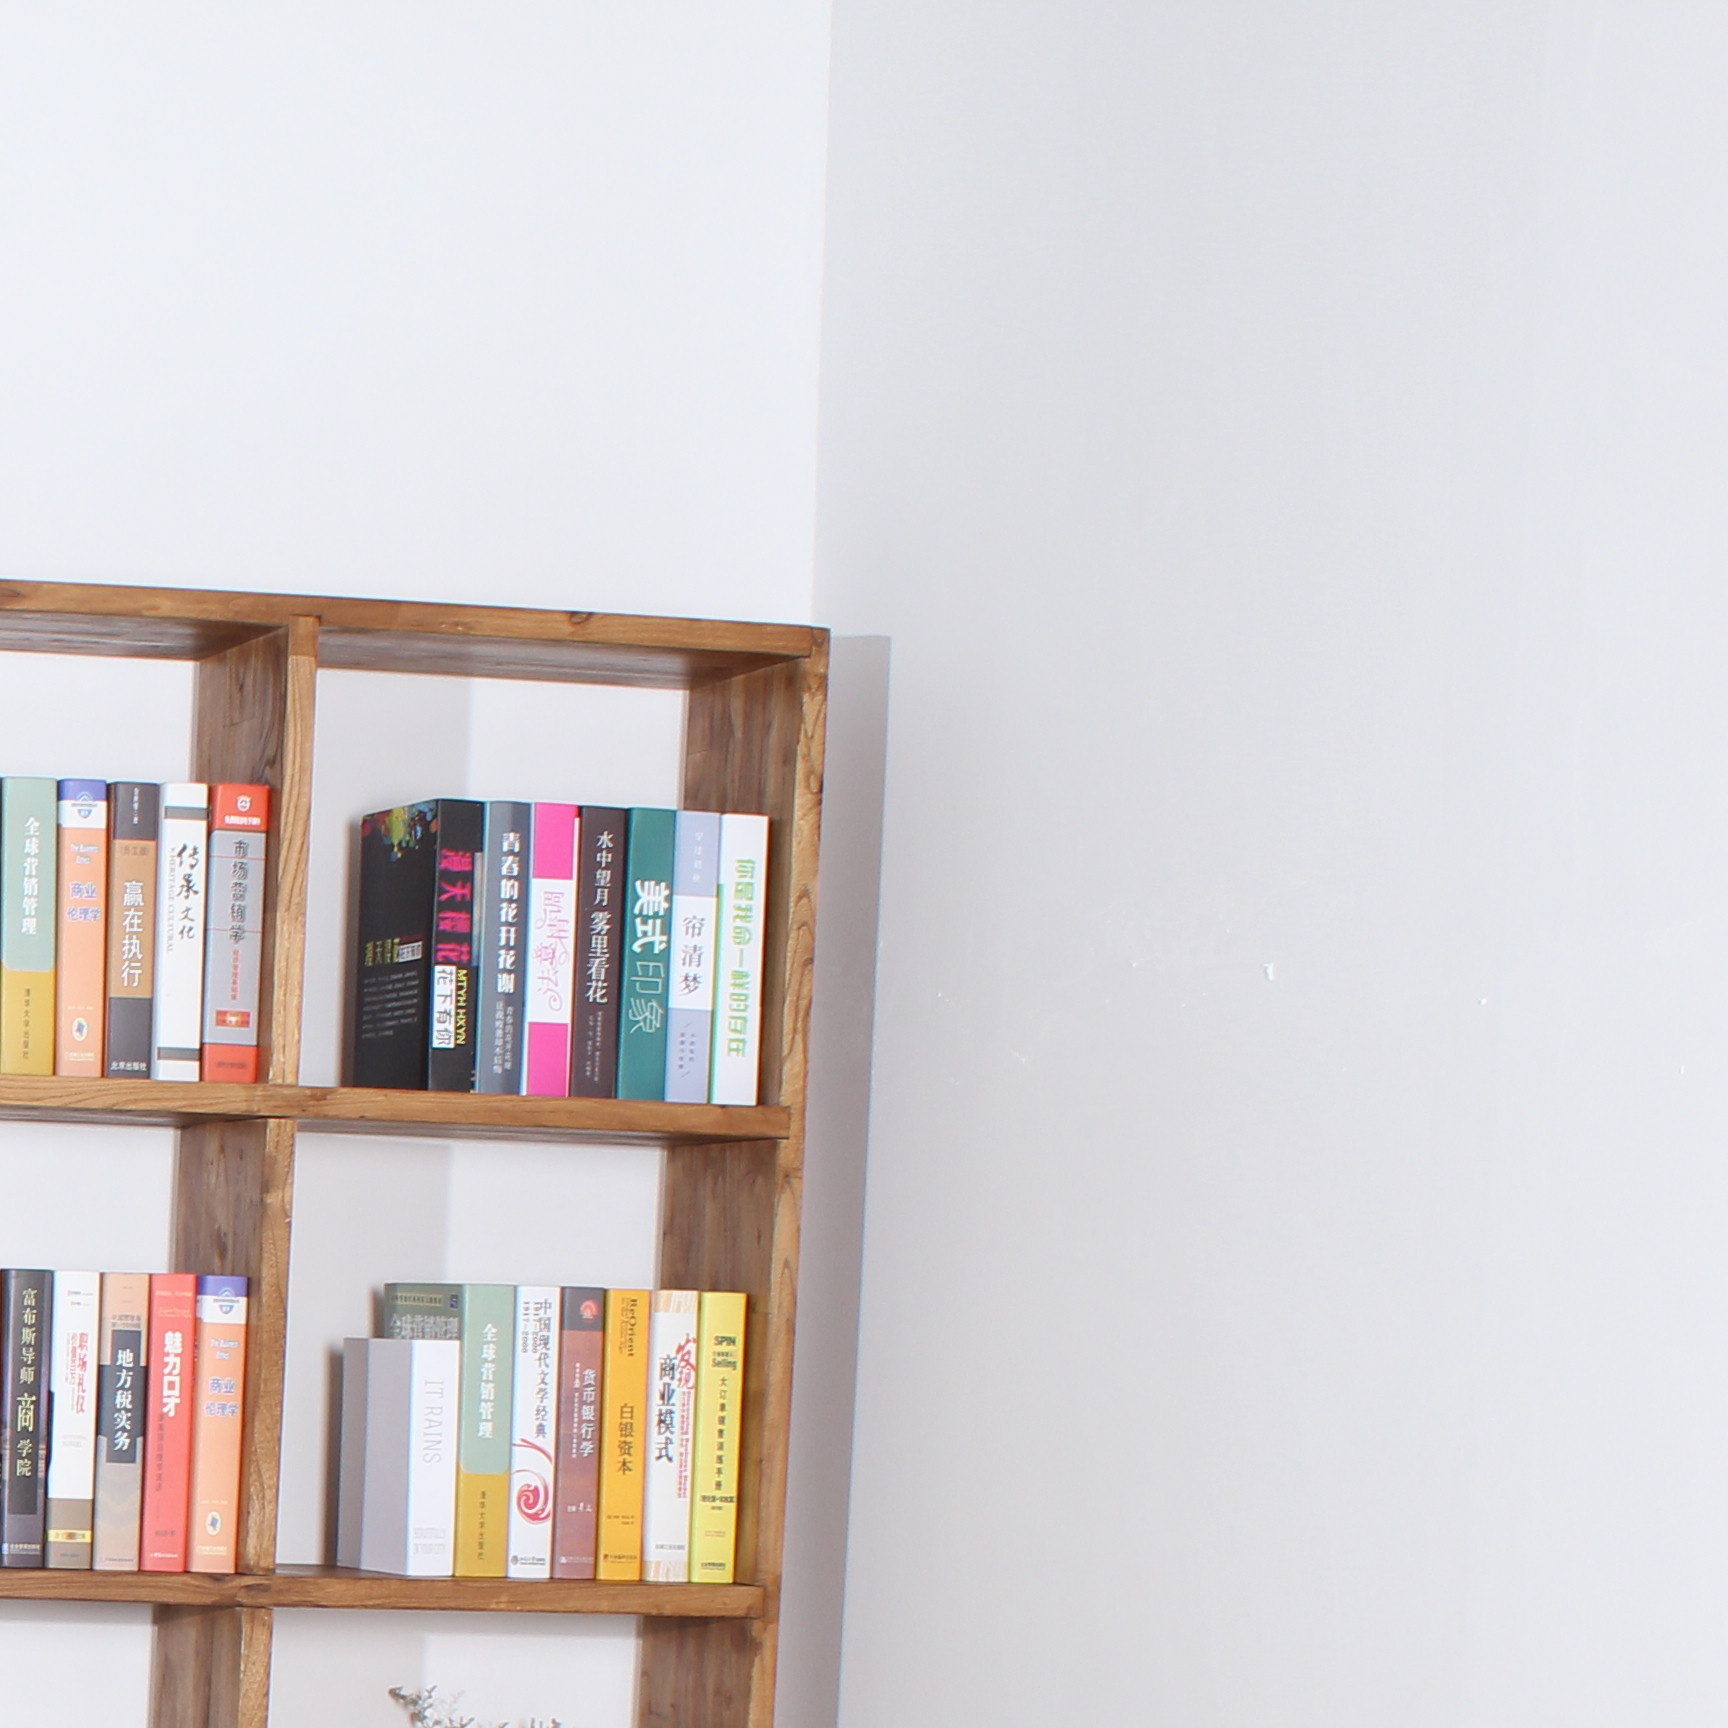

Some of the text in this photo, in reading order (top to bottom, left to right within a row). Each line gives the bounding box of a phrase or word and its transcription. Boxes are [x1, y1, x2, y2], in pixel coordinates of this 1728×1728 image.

[21, 816, 41, 936] 全球营销管理
[70, 881, 96, 899] 商业
[176, 843, 200, 940] 传承文化
[228, 840, 249, 945] 市场营销学
[497, 831, 520, 994] 青春的花开花谢
[594, 831, 615, 906] 水中望月
[67, 906, 101, 922] 伦理学
[121, 880, 145, 988] 赢在执行
[585, 911, 612, 1004] 雾里看花
[630, 879, 672, 1034] 美式印象
[680, 914, 706, 996] 帘清梦
[727, 858, 756, 1058] 你是我命一样的存在
[435, 966, 455, 1047] 花下有你
[456, 969, 468, 1045] MTYH HXYN
[16, 1288, 38, 1477] 富布斯导师 商学院
[162, 1331, 184, 1418] 魅力口才
[209, 1376, 236, 1394] 商业
[477, 1323, 498, 1439] 全球营销管理
[535, 1299, 553, 1439] 中国现代文学经典
[676, 1333, 697, 1390] 发现
[712, 1358, 737, 1371] Selling
[714, 1336, 737, 1347] SPIN
[114, 1348, 135, 1451] 地方税实务
[204, 1402, 240, 1417] 伦理学
[422, 1380, 444, 1464] IT RAINS
[579, 1368, 597, 1458] 货币银行学
[617, 1403, 635, 1476] 白银资本
[655, 1355, 677, 1464] 商业模式
